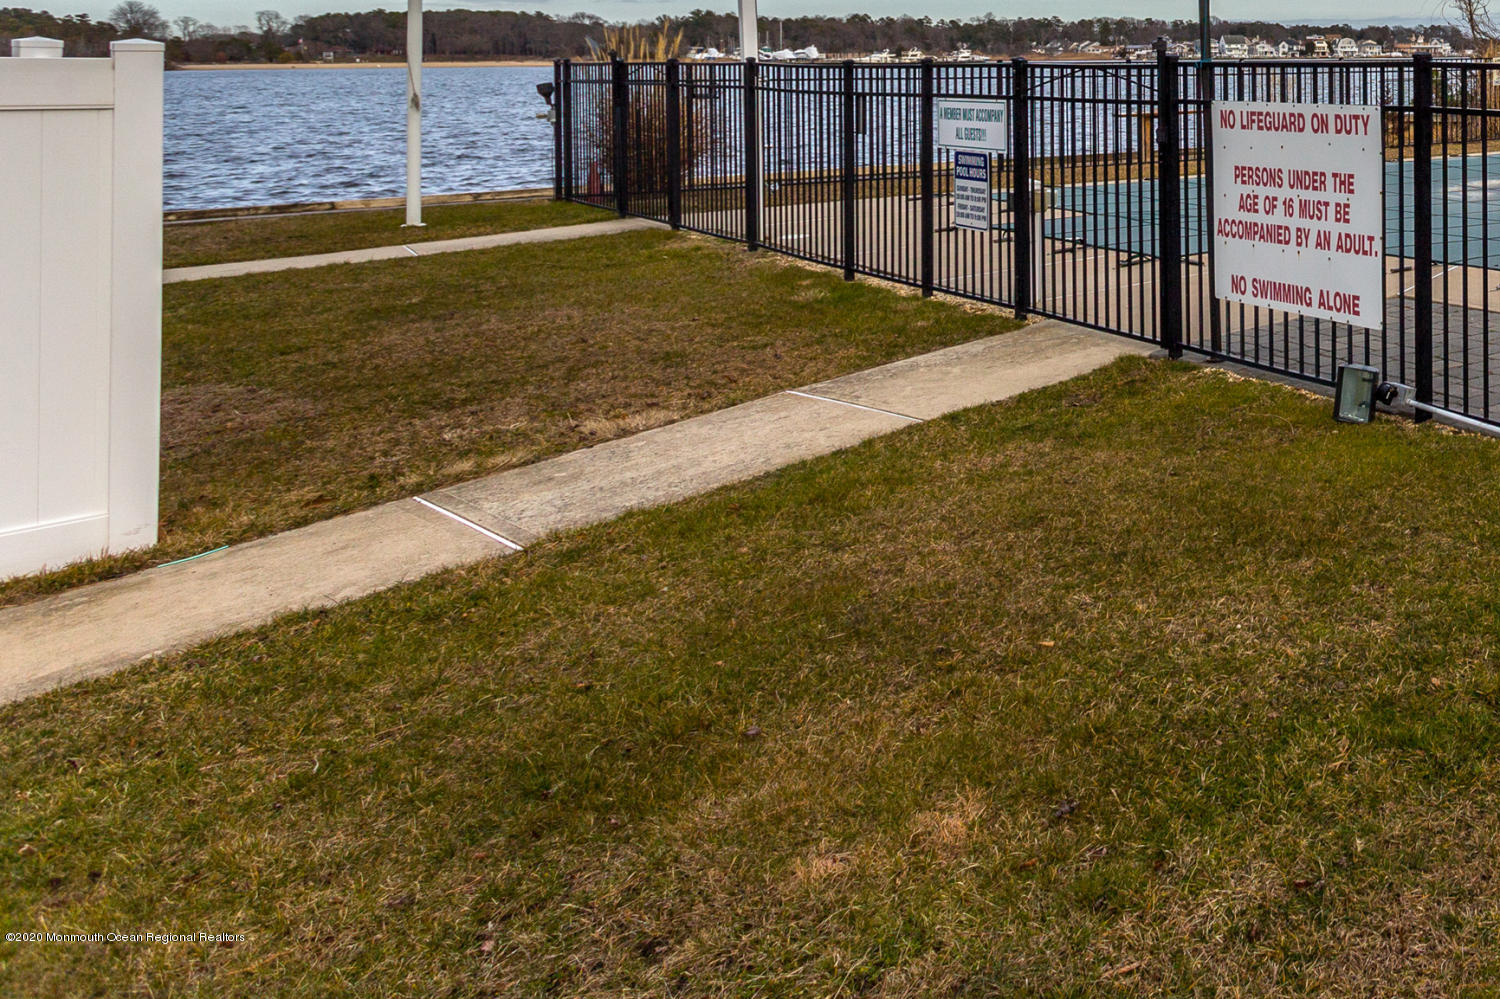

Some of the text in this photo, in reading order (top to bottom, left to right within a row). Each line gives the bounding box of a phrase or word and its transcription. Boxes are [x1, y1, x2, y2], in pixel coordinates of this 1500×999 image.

[944, 107, 961, 120] MEMBER
[963, 108, 975, 121] MUST
[976, 109, 1003, 123] ACCOMPANY
[1220, 109, 1370, 136] NO LIFEGUARD ON DUTY
[956, 166, 987, 179] POOL HOURS
[1234, 165, 1355, 194] PERSONS UNDER THE
[1238, 193, 1350, 224] AGE OF 16 MUST BE
[1217, 218, 1378, 257] ACCOMPANIED BY AN ADULT.
[1231, 274, 1360, 316] NO SWIMMING ALONE
